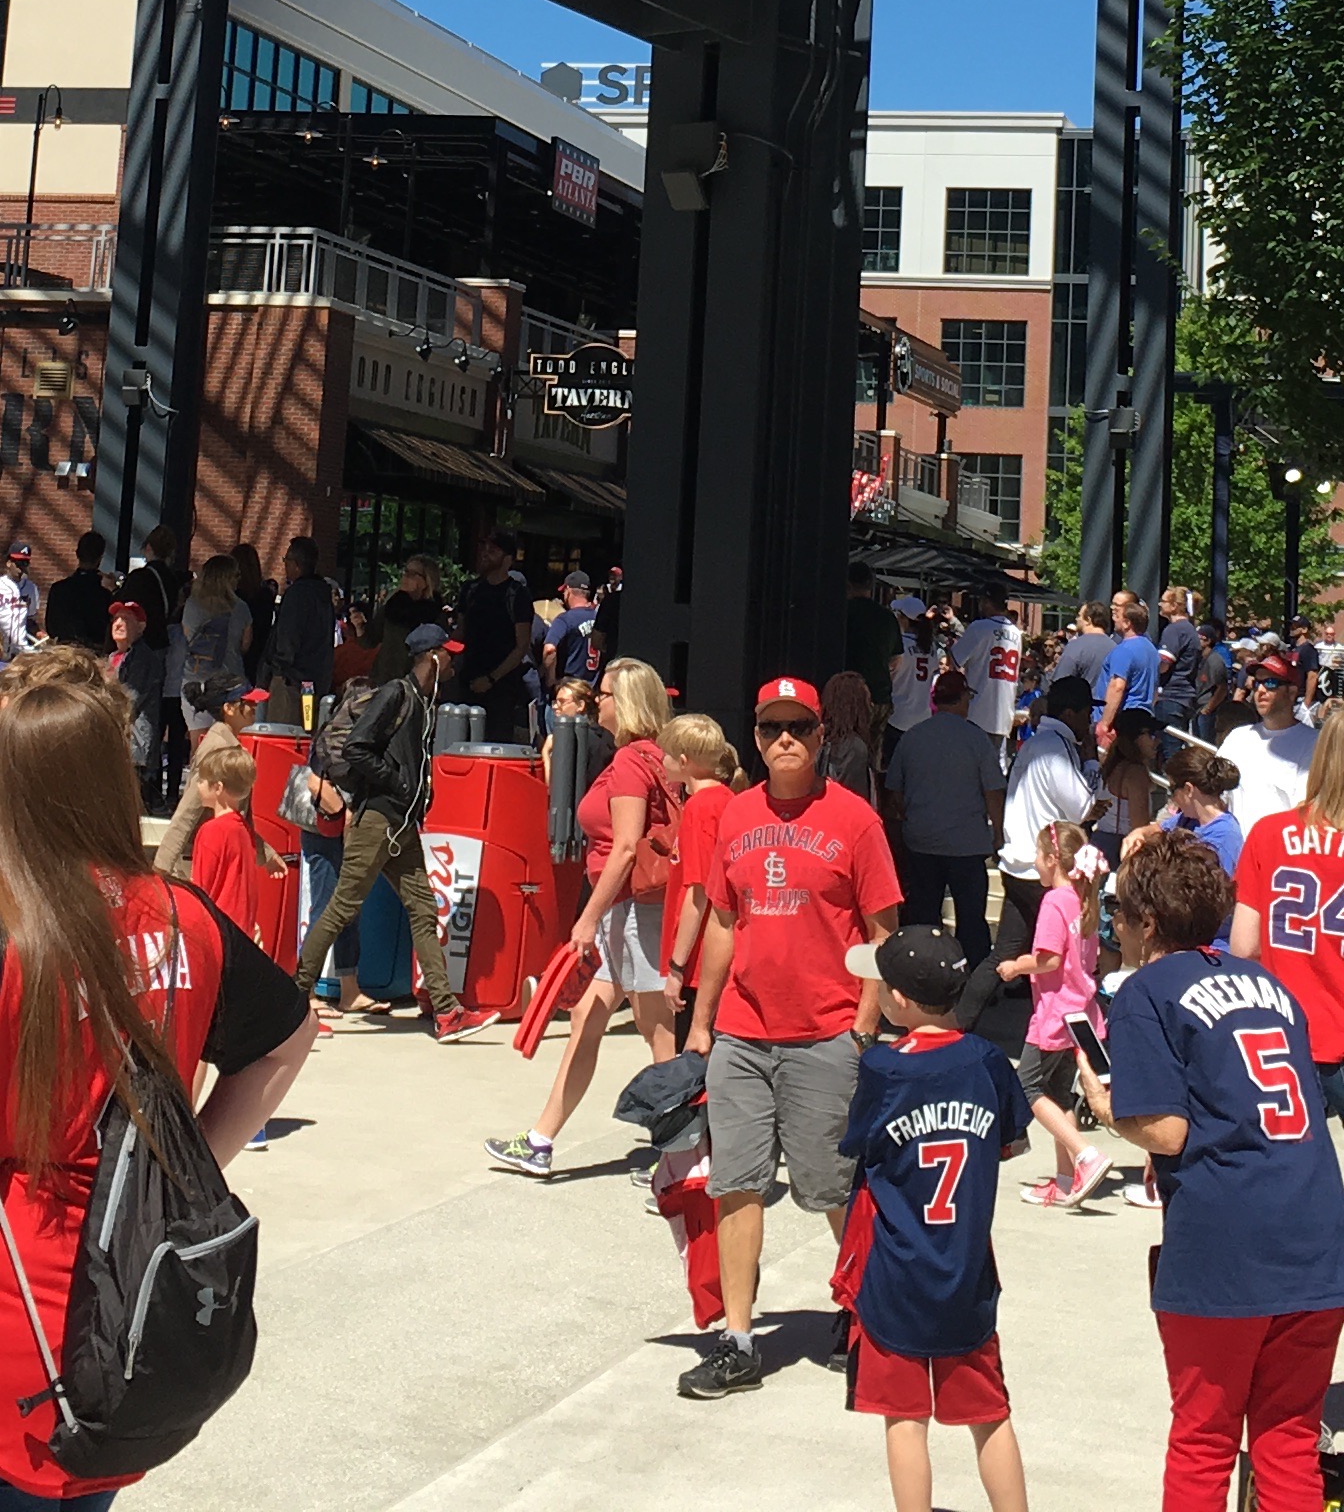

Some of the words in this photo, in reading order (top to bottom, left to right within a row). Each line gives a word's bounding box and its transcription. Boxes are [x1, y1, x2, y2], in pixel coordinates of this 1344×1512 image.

[560, 158, 595, 190] PBR
[557, 179, 596, 211] ATLANTA
[536, 359, 575, 374] TODD
[914, 363, 936, 387] SPORTS
[357, 355, 392, 396] ODD
[405, 369, 478, 419] ENGLISH
[916, 657, 929, 682] 5
[988, 646, 1019, 682] 29
[730, 823, 844, 862] CARDINALS
[449, 868, 474, 959] LIGHT
[1178, 974, 1296, 1030] FREEMAN
[1232, 1027, 1310, 1141] 5
[885, 1100, 996, 1147] FRANCOEUR
[918, 1138, 969, 1225] 7
